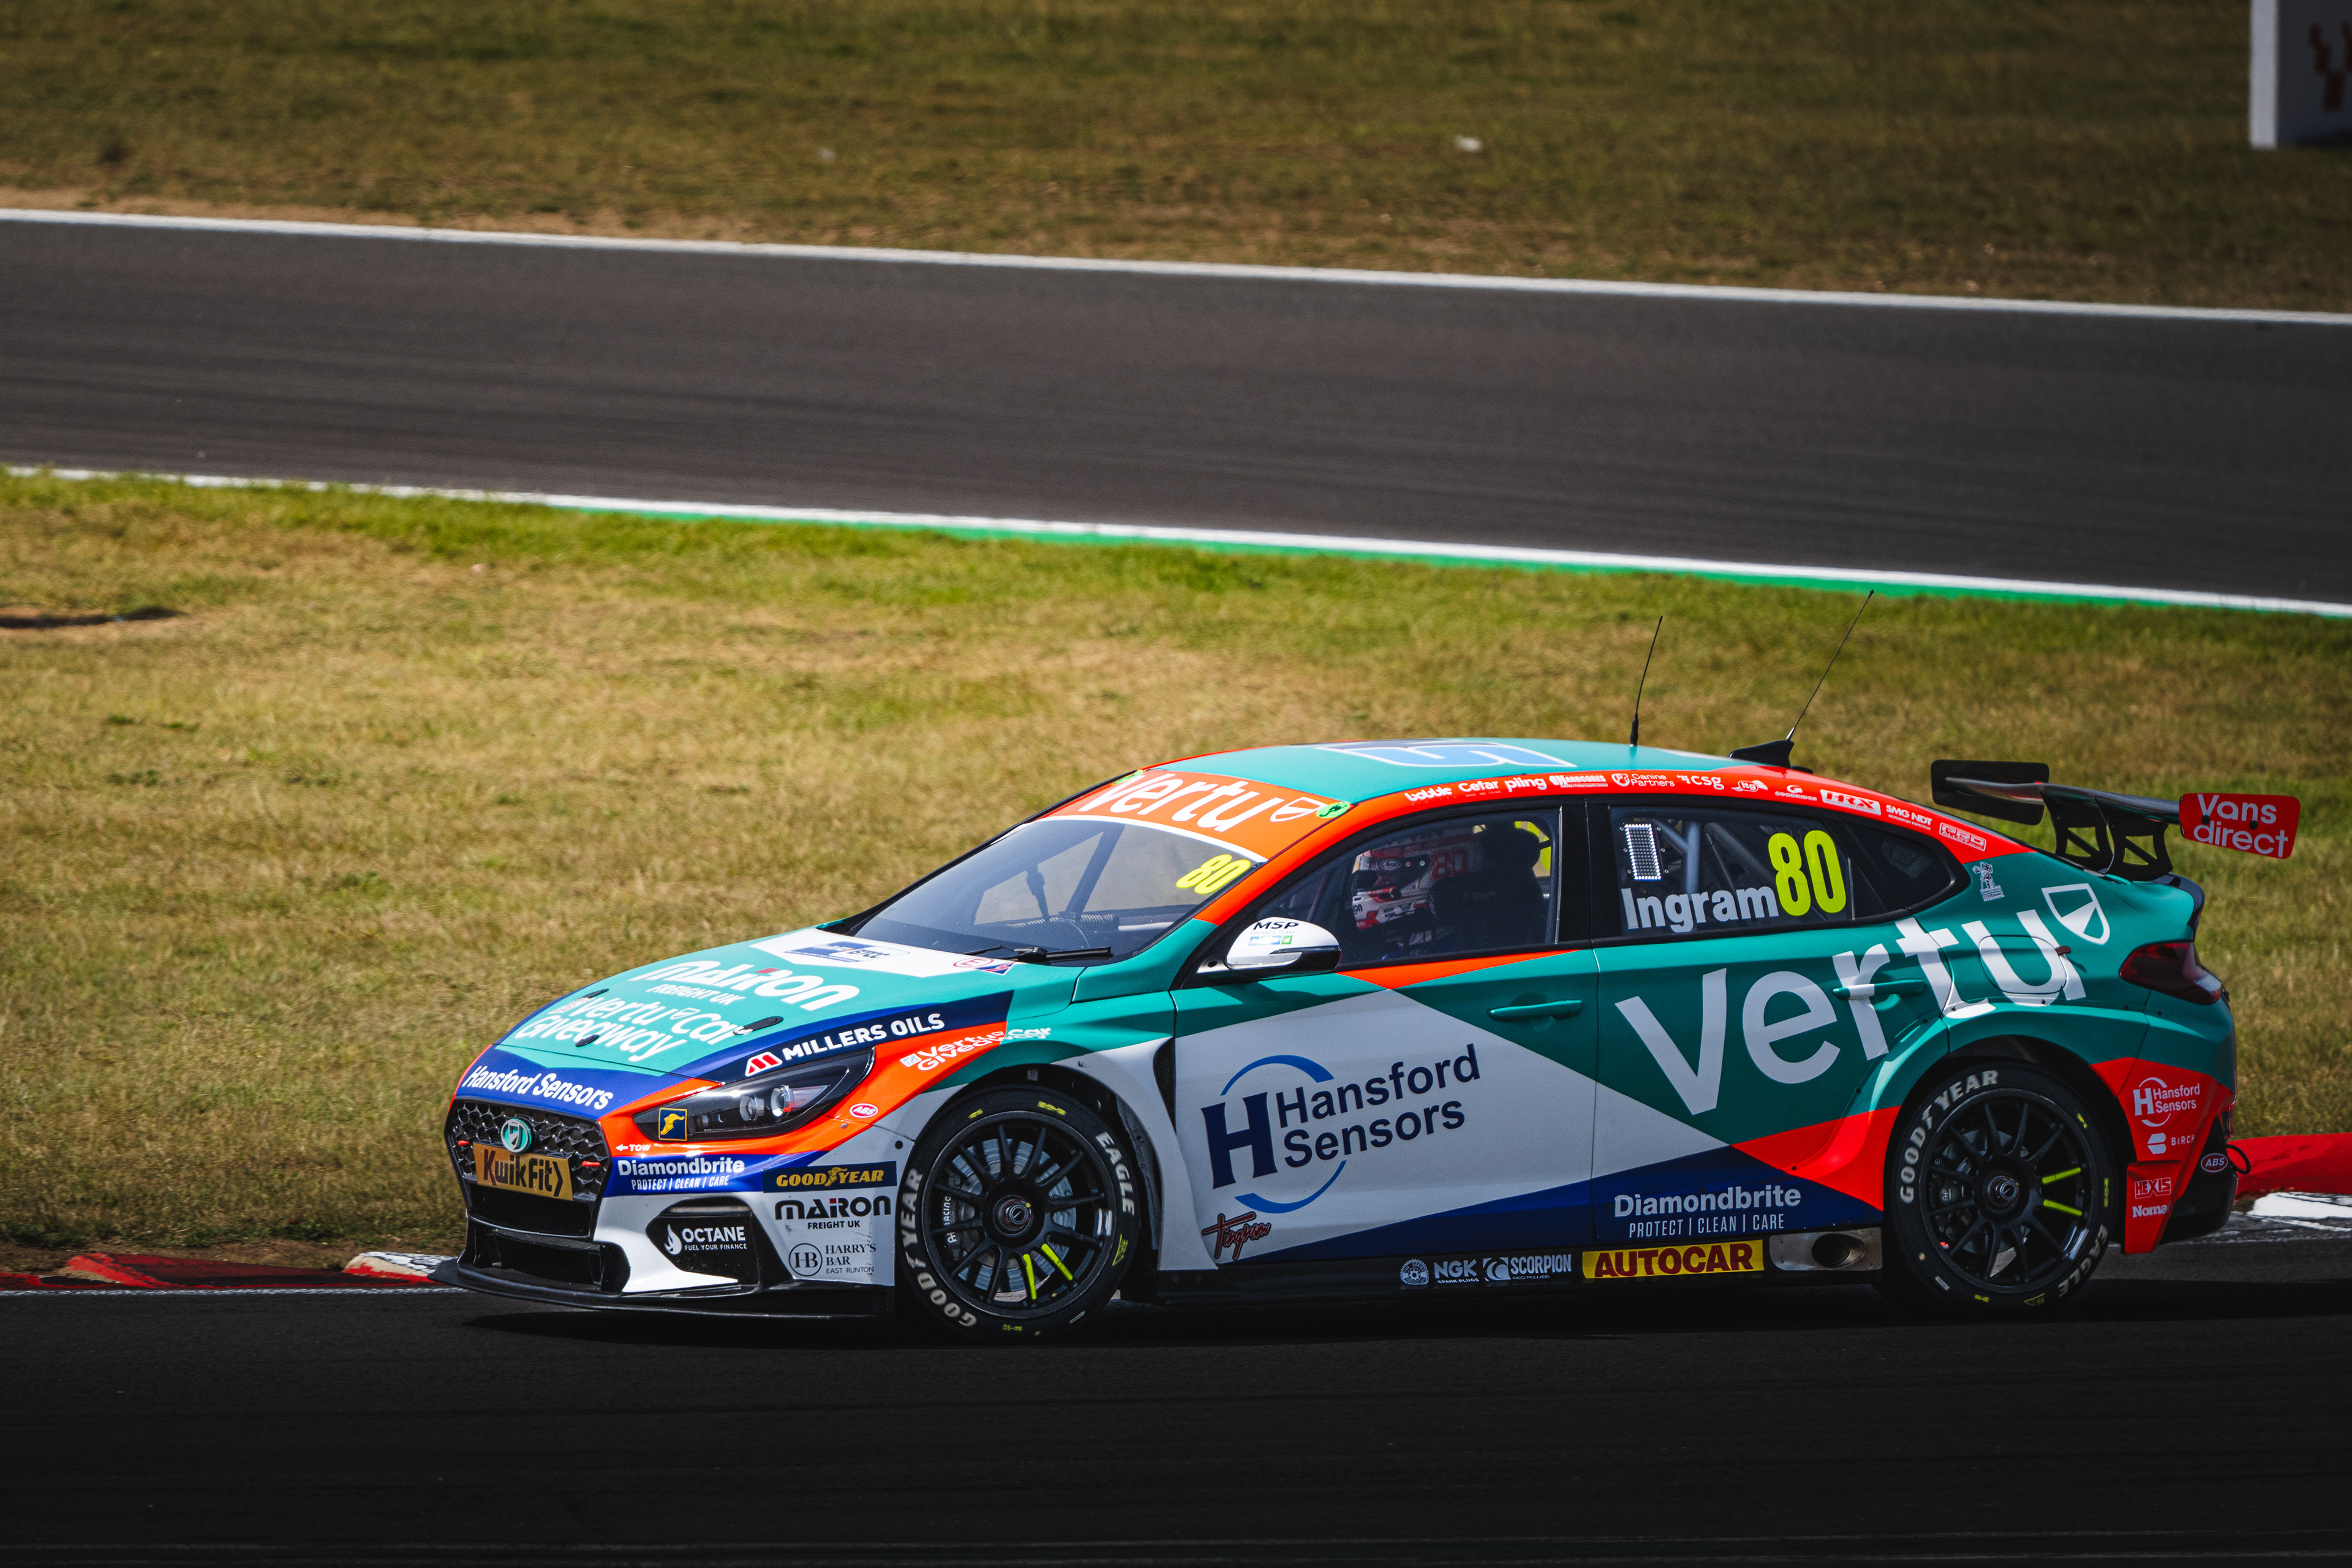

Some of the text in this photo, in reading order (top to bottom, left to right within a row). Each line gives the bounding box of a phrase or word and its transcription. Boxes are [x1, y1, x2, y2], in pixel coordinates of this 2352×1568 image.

[1458, 780, 1499, 792] Cefar
[1504, 777, 1547, 793] piing
[1774, 791, 1817, 801] GOODRIDGE
[1886, 804, 1910, 818] SMG
[1911, 813, 1932, 826] NDT
[2197, 794, 2277, 823] Vans
[2193, 821, 2288, 858] direct
[1176, 854, 1251, 894] 80
[1768, 830, 1847, 916] 80
[1621, 887, 1779, 933] Ingram
[1253, 921, 1299, 930] MSP
[646, 984, 745, 1005] FREIGHT UK
[782, 1024, 887, 1061] MILLERS
[891, 1013, 944, 1036] OILS
[462, 1065, 614, 1110] Hansford Sensors
[1276, 1042, 1480, 1128] Hansford
[2153, 1083, 2200, 1100] Hansford
[853, 1105, 877, 1115] ABS
[2156, 1099, 2196, 1114] Sensors
[1284, 1100, 1465, 1168] Sensors
[617, 1156, 745, 1176] Diamondbrite
[2205, 1157, 2225, 1167] ABS
[631, 1175, 729, 1190] PROTECT CLEAN CARE
[1096, 1131, 1134, 1216] EAGLE
[2135, 1178, 2171, 1198] HEXIS
[1614, 1185, 1801, 1218] Diamondbrite
[682, 1226, 745, 1243] OCTANE
[807, 1221, 843, 1230] FREIGHT
[1629, 1213, 1784, 1238] PROTECT CLEAN CARE
[825, 1243, 876, 1255] HARRY'S
[825, 1256, 851, 1266] BAR
[1434, 1259, 1477, 1279] NGK
[1510, 1254, 1572, 1275] SCORPION
[1594, 1243, 1753, 1278] AUTOCAR
